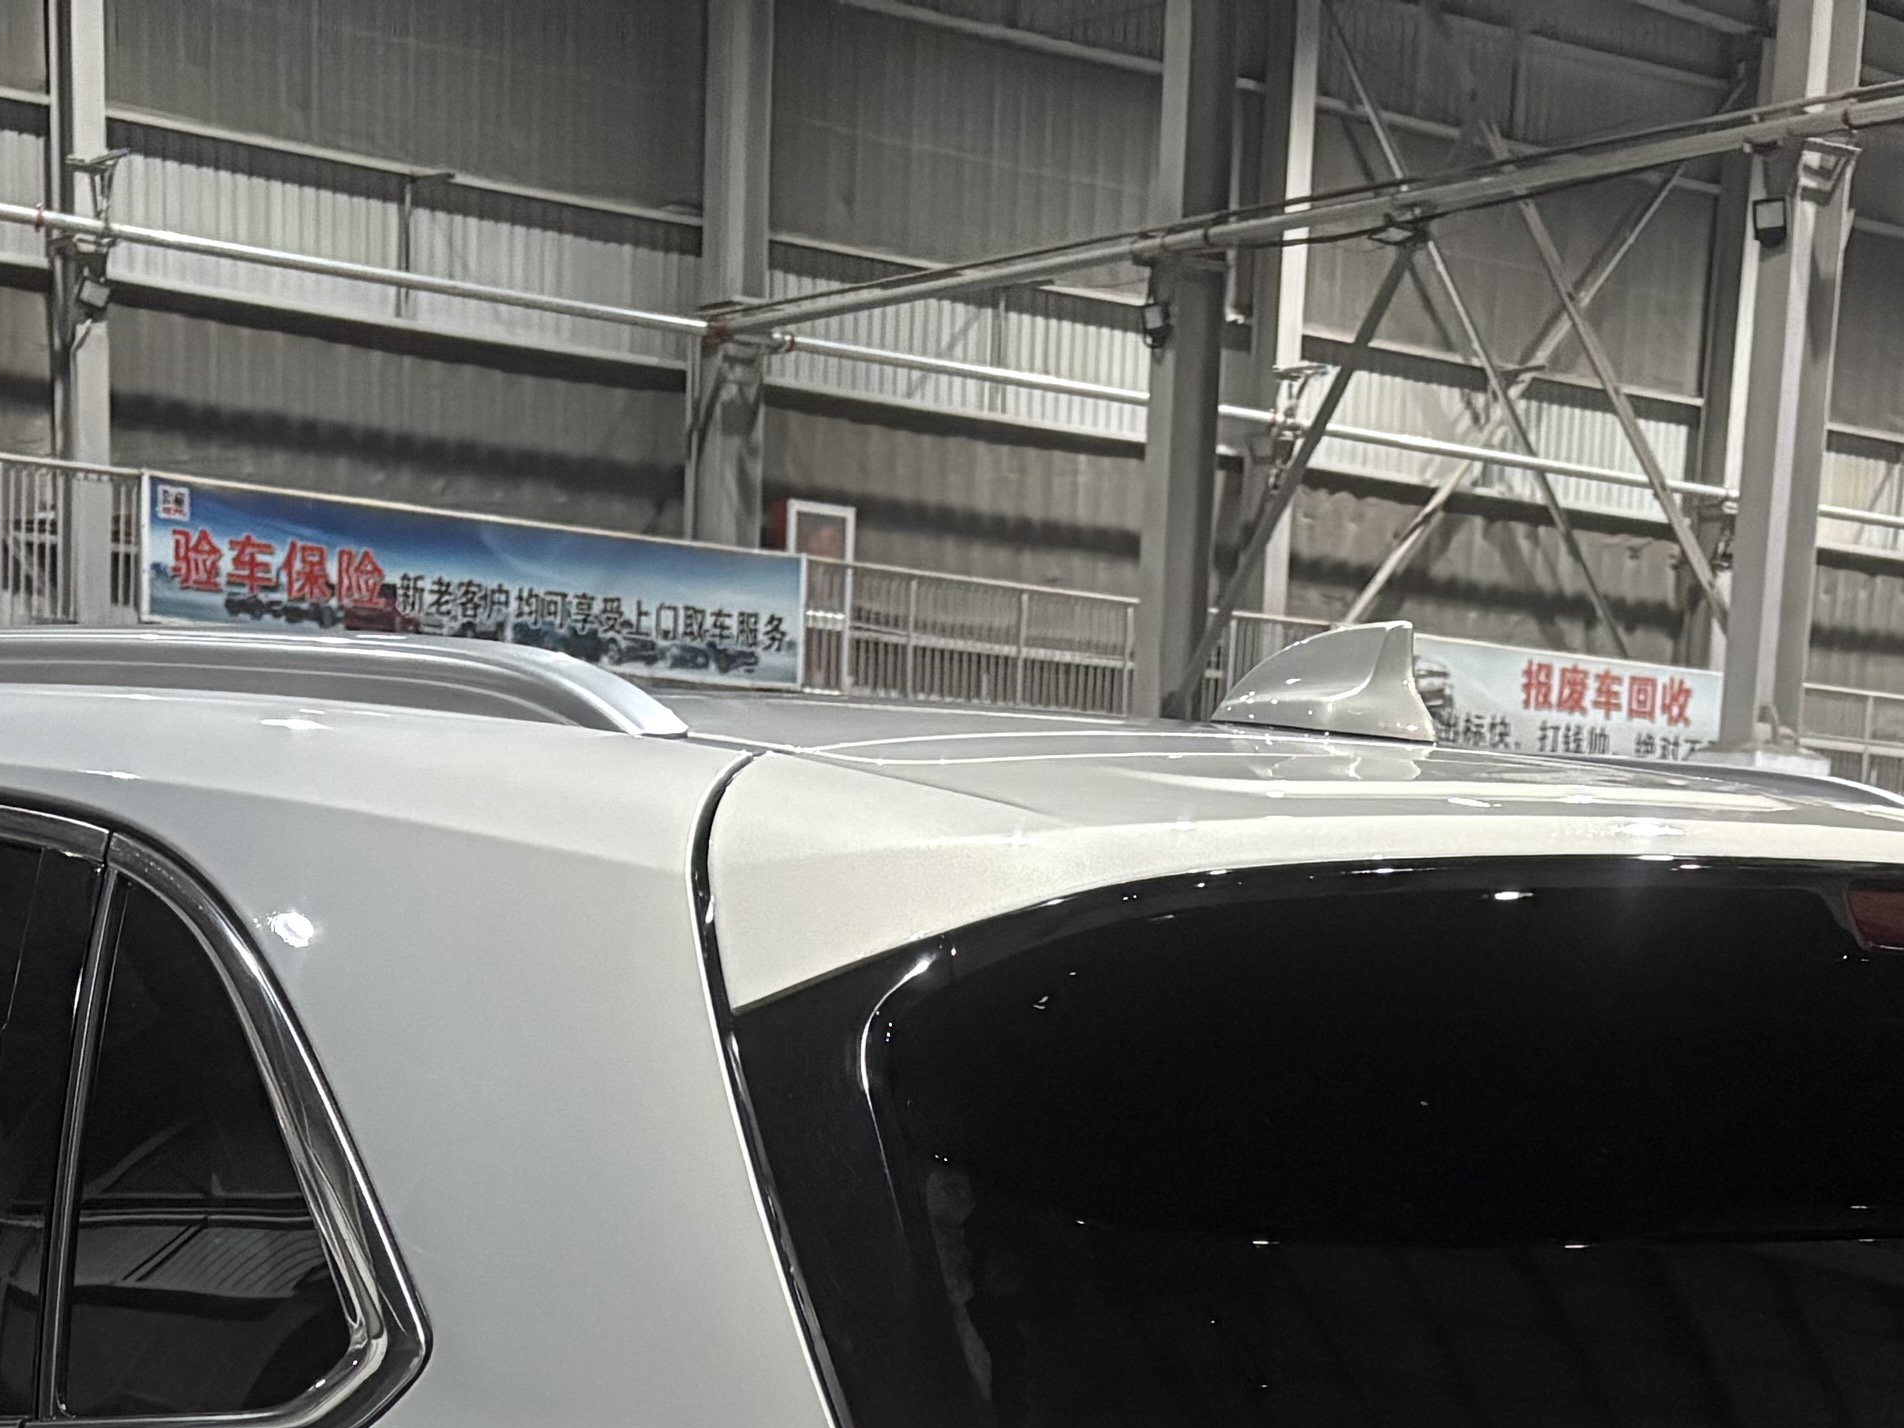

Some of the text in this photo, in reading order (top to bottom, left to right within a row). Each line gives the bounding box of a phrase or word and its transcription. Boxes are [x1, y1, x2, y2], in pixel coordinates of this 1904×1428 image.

[171, 528, 789, 653] 验车保险 新老客户均可享受上门取车服务
[1521, 658, 1695, 728] 报废车回收
